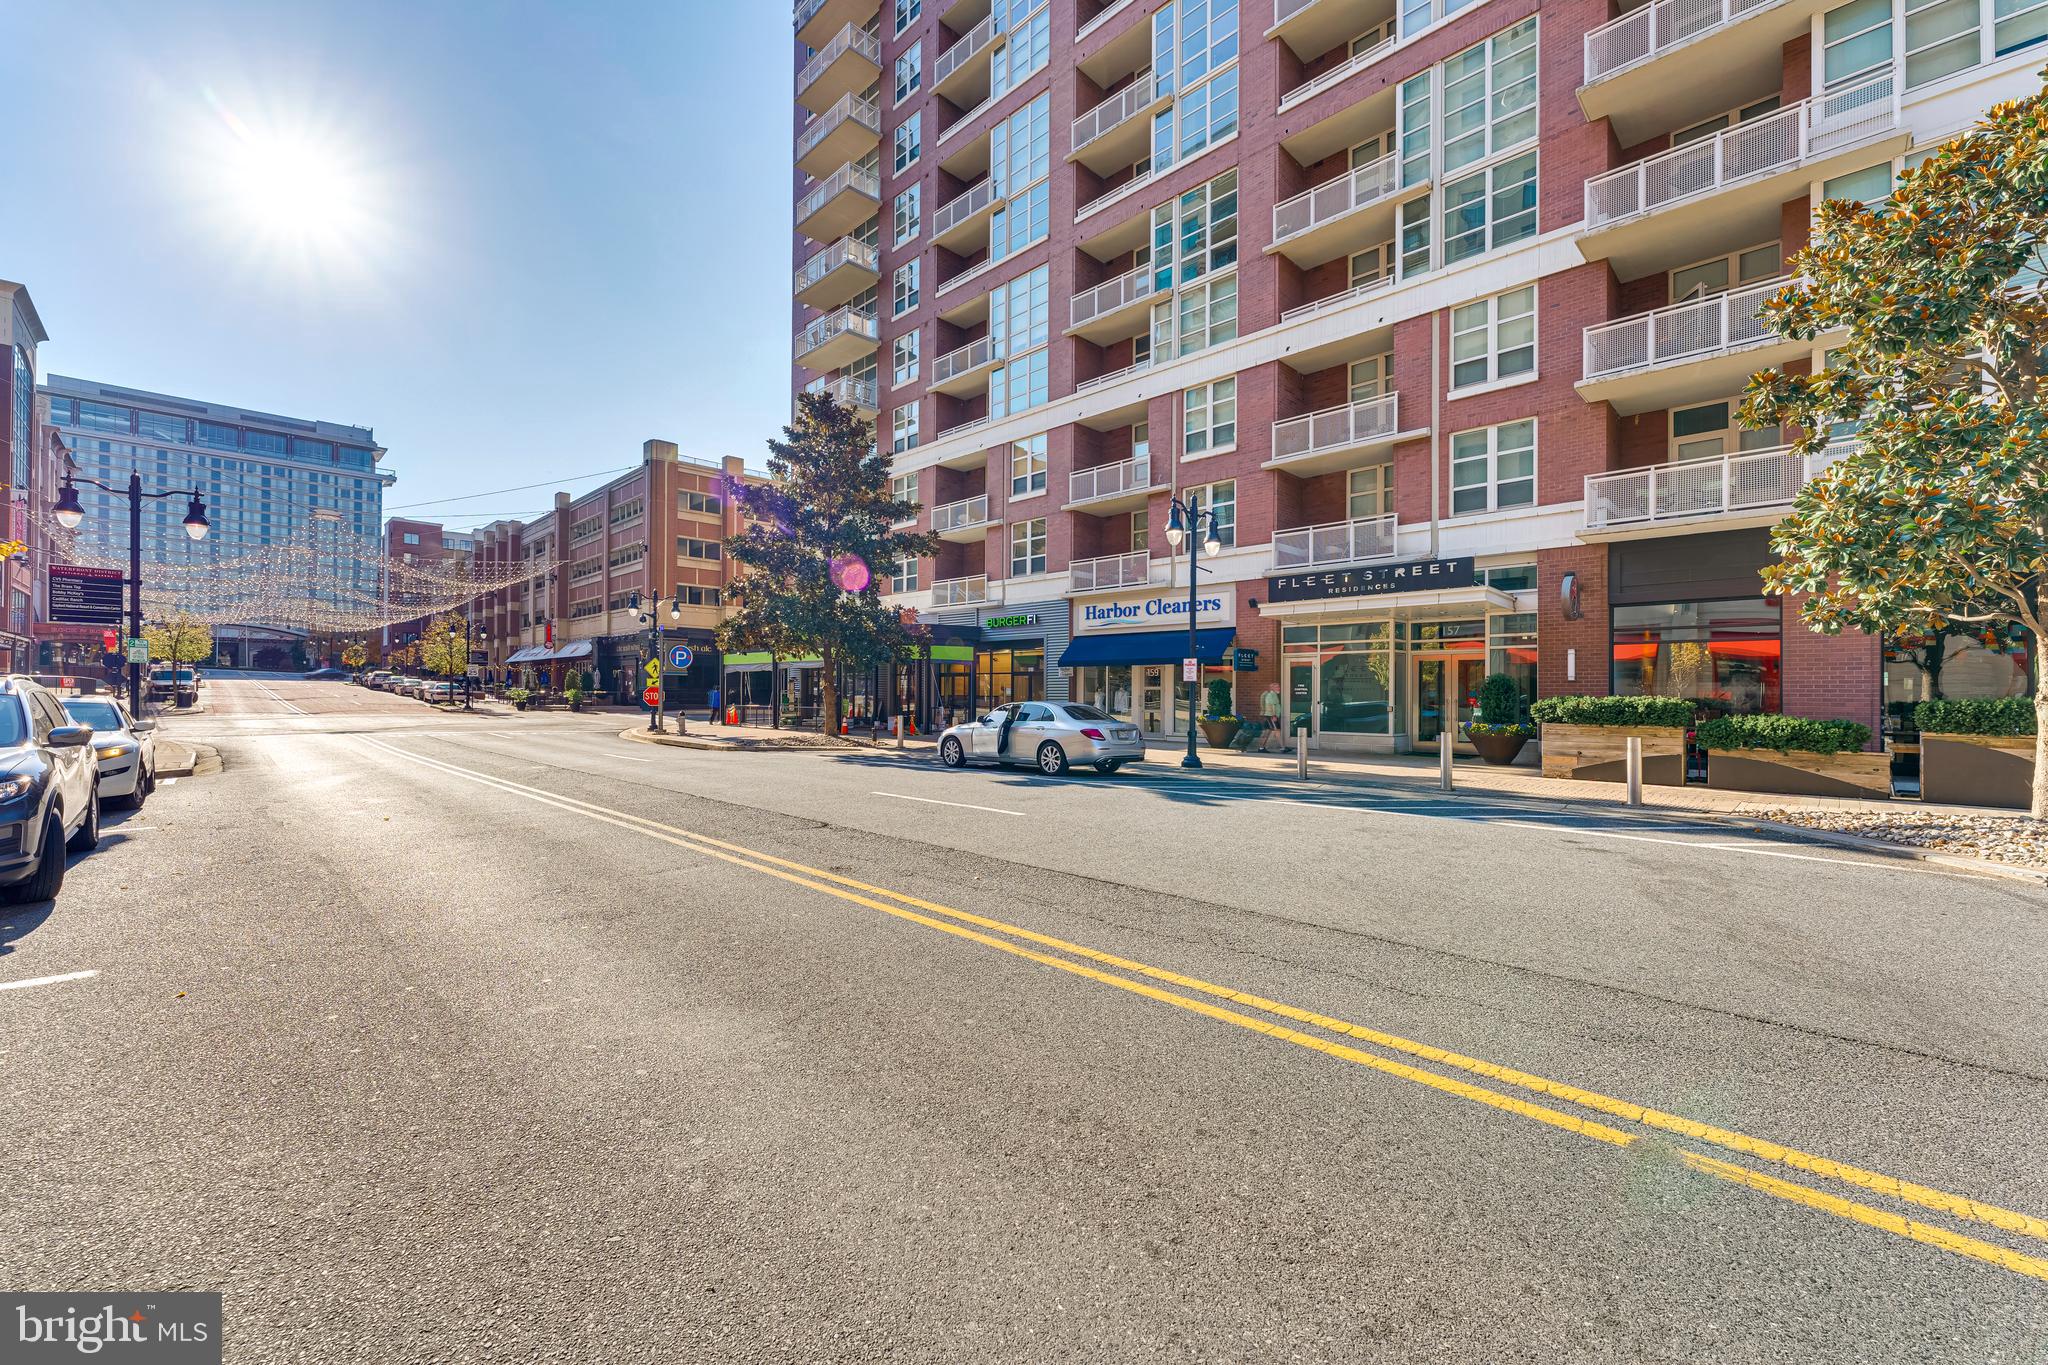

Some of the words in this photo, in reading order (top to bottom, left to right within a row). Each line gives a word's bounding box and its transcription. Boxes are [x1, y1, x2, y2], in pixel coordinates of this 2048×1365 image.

[1278, 572, 1351, 589] FLEET
[1362, 562, 1457, 580] STREET
[1328, 583, 1396, 594] RESIDENCES
[1085, 603, 1140, 620] Harbor
[1146, 598, 1221, 616] Cleaners
[986, 614, 1036, 628] BURGERFI
[1443, 626, 1460, 636] 157
[676, 651, 687, 665] P
[1146, 668, 1159, 676] 159
[645, 692, 658, 700] STO
